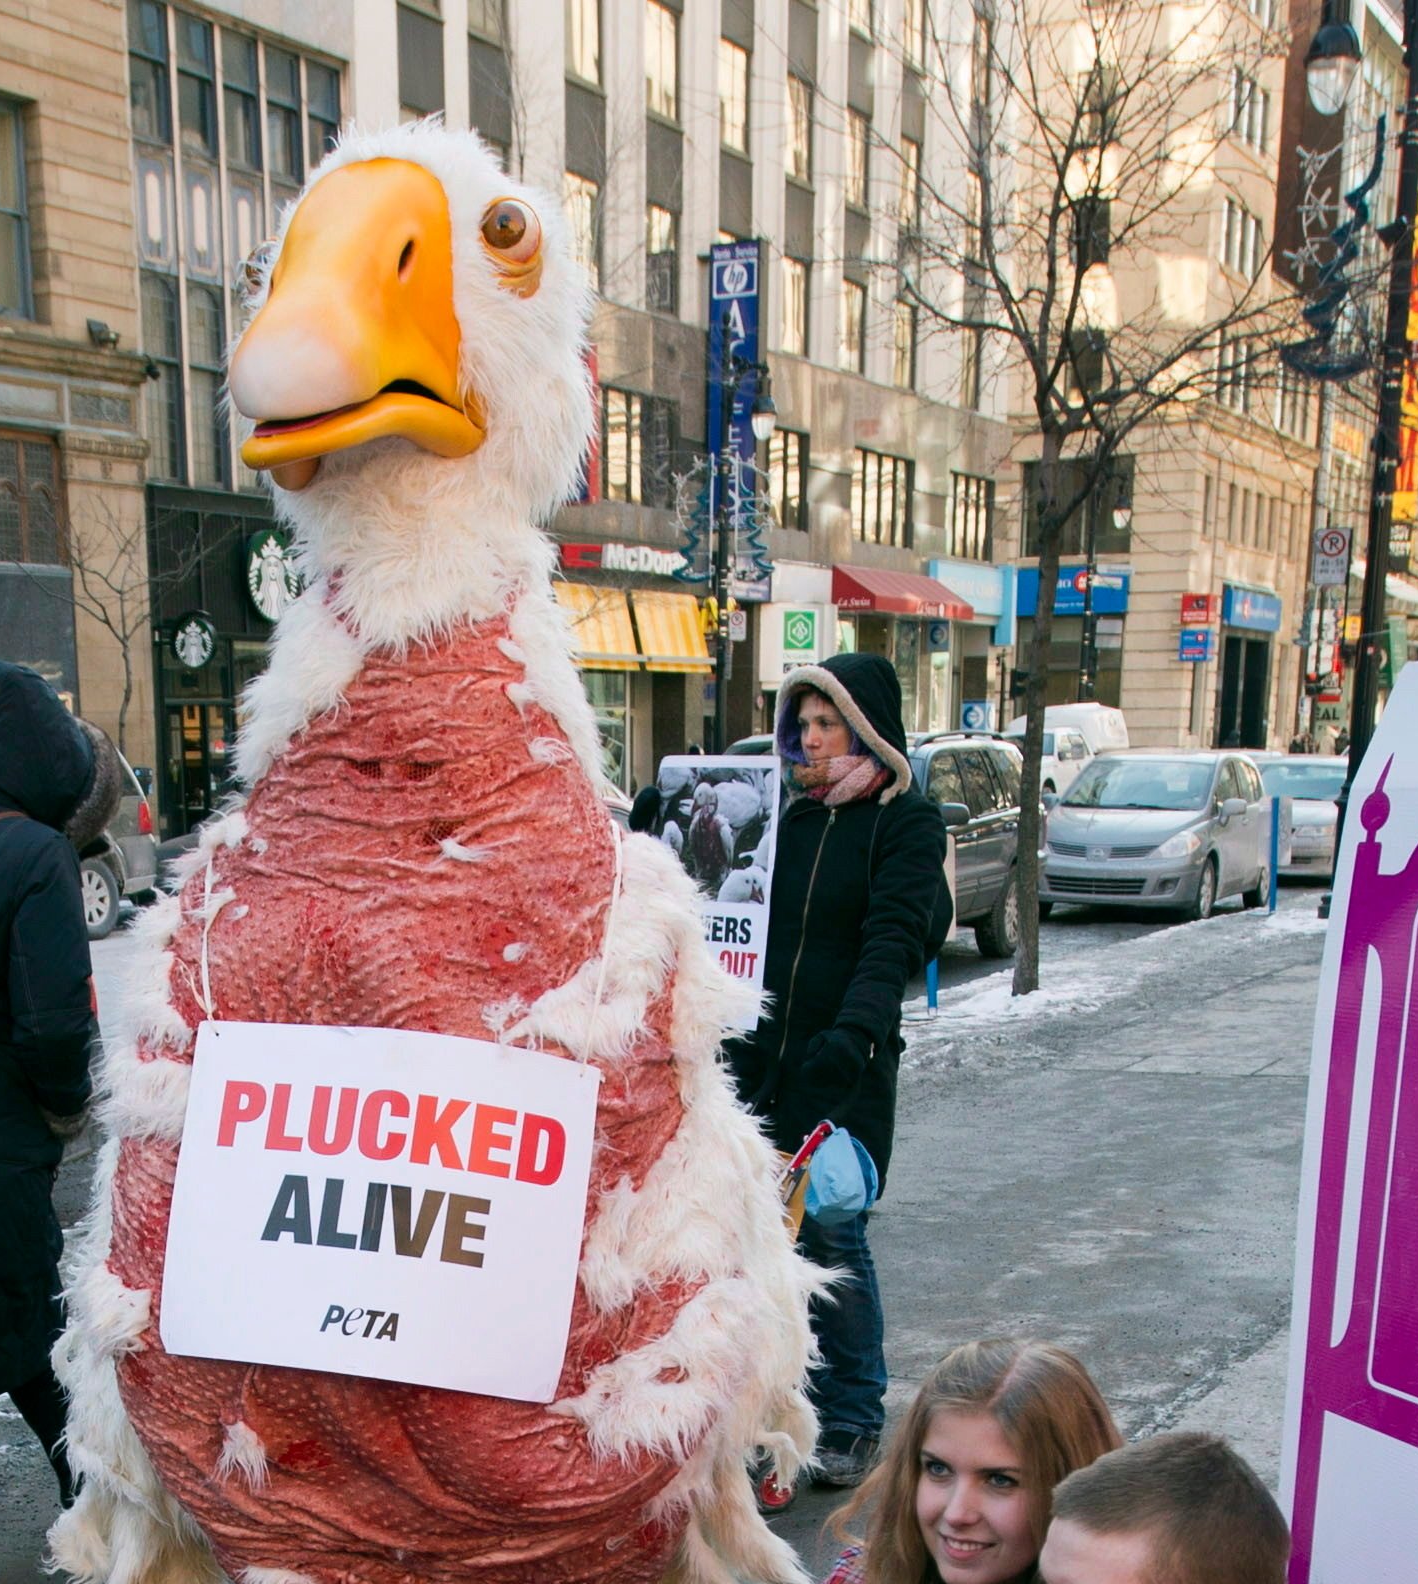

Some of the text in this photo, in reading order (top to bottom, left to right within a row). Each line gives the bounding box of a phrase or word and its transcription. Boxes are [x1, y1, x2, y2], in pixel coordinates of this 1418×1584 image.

[703, 915, 752, 945] ERS
[719, 950, 758, 979] OUT
[217, 1080, 567, 1187] PLUCKED
[261, 1174, 492, 1269] ALIVE
